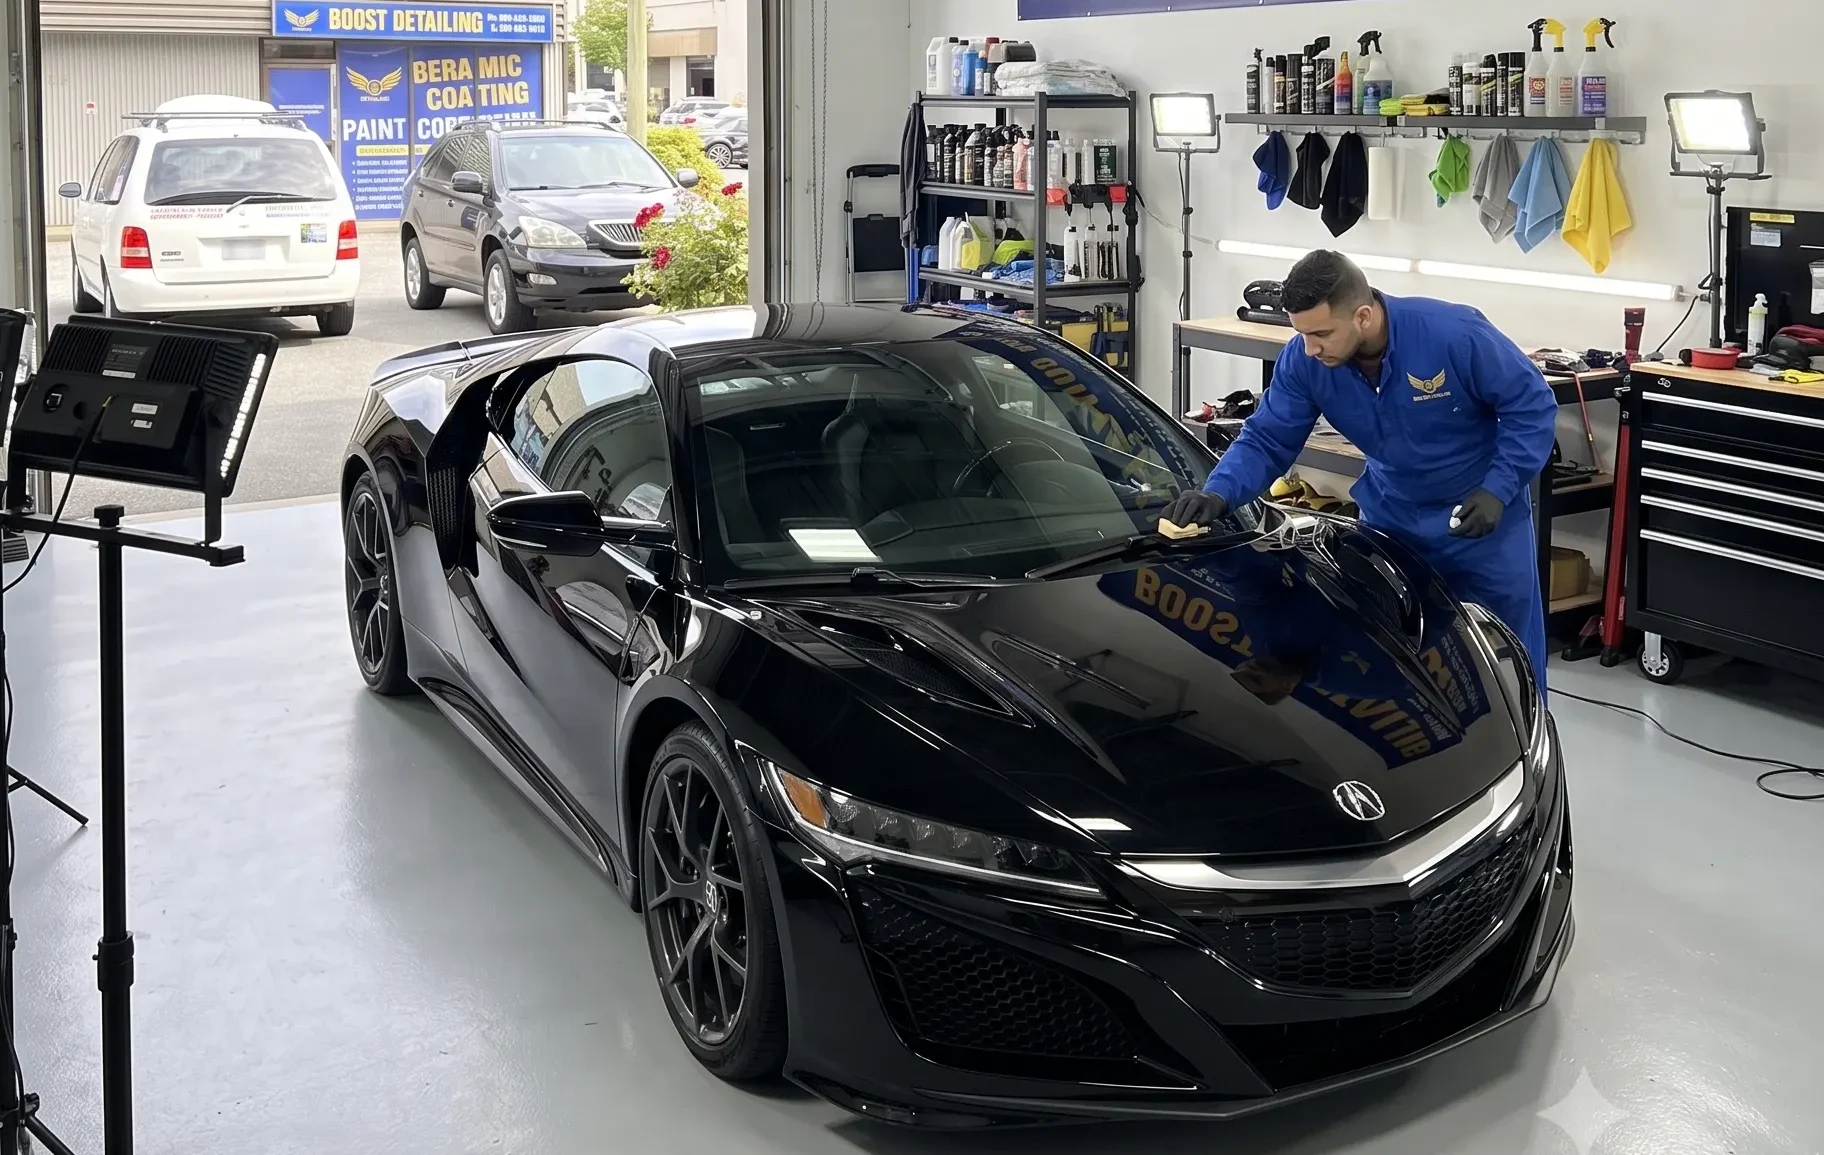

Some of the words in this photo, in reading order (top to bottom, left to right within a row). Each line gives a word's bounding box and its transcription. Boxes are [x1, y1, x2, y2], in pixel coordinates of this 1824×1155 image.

[328, 7, 387, 31] BOOST
[393, 9, 483, 33] DETAILING
[343, 117, 407, 141] PAINT
